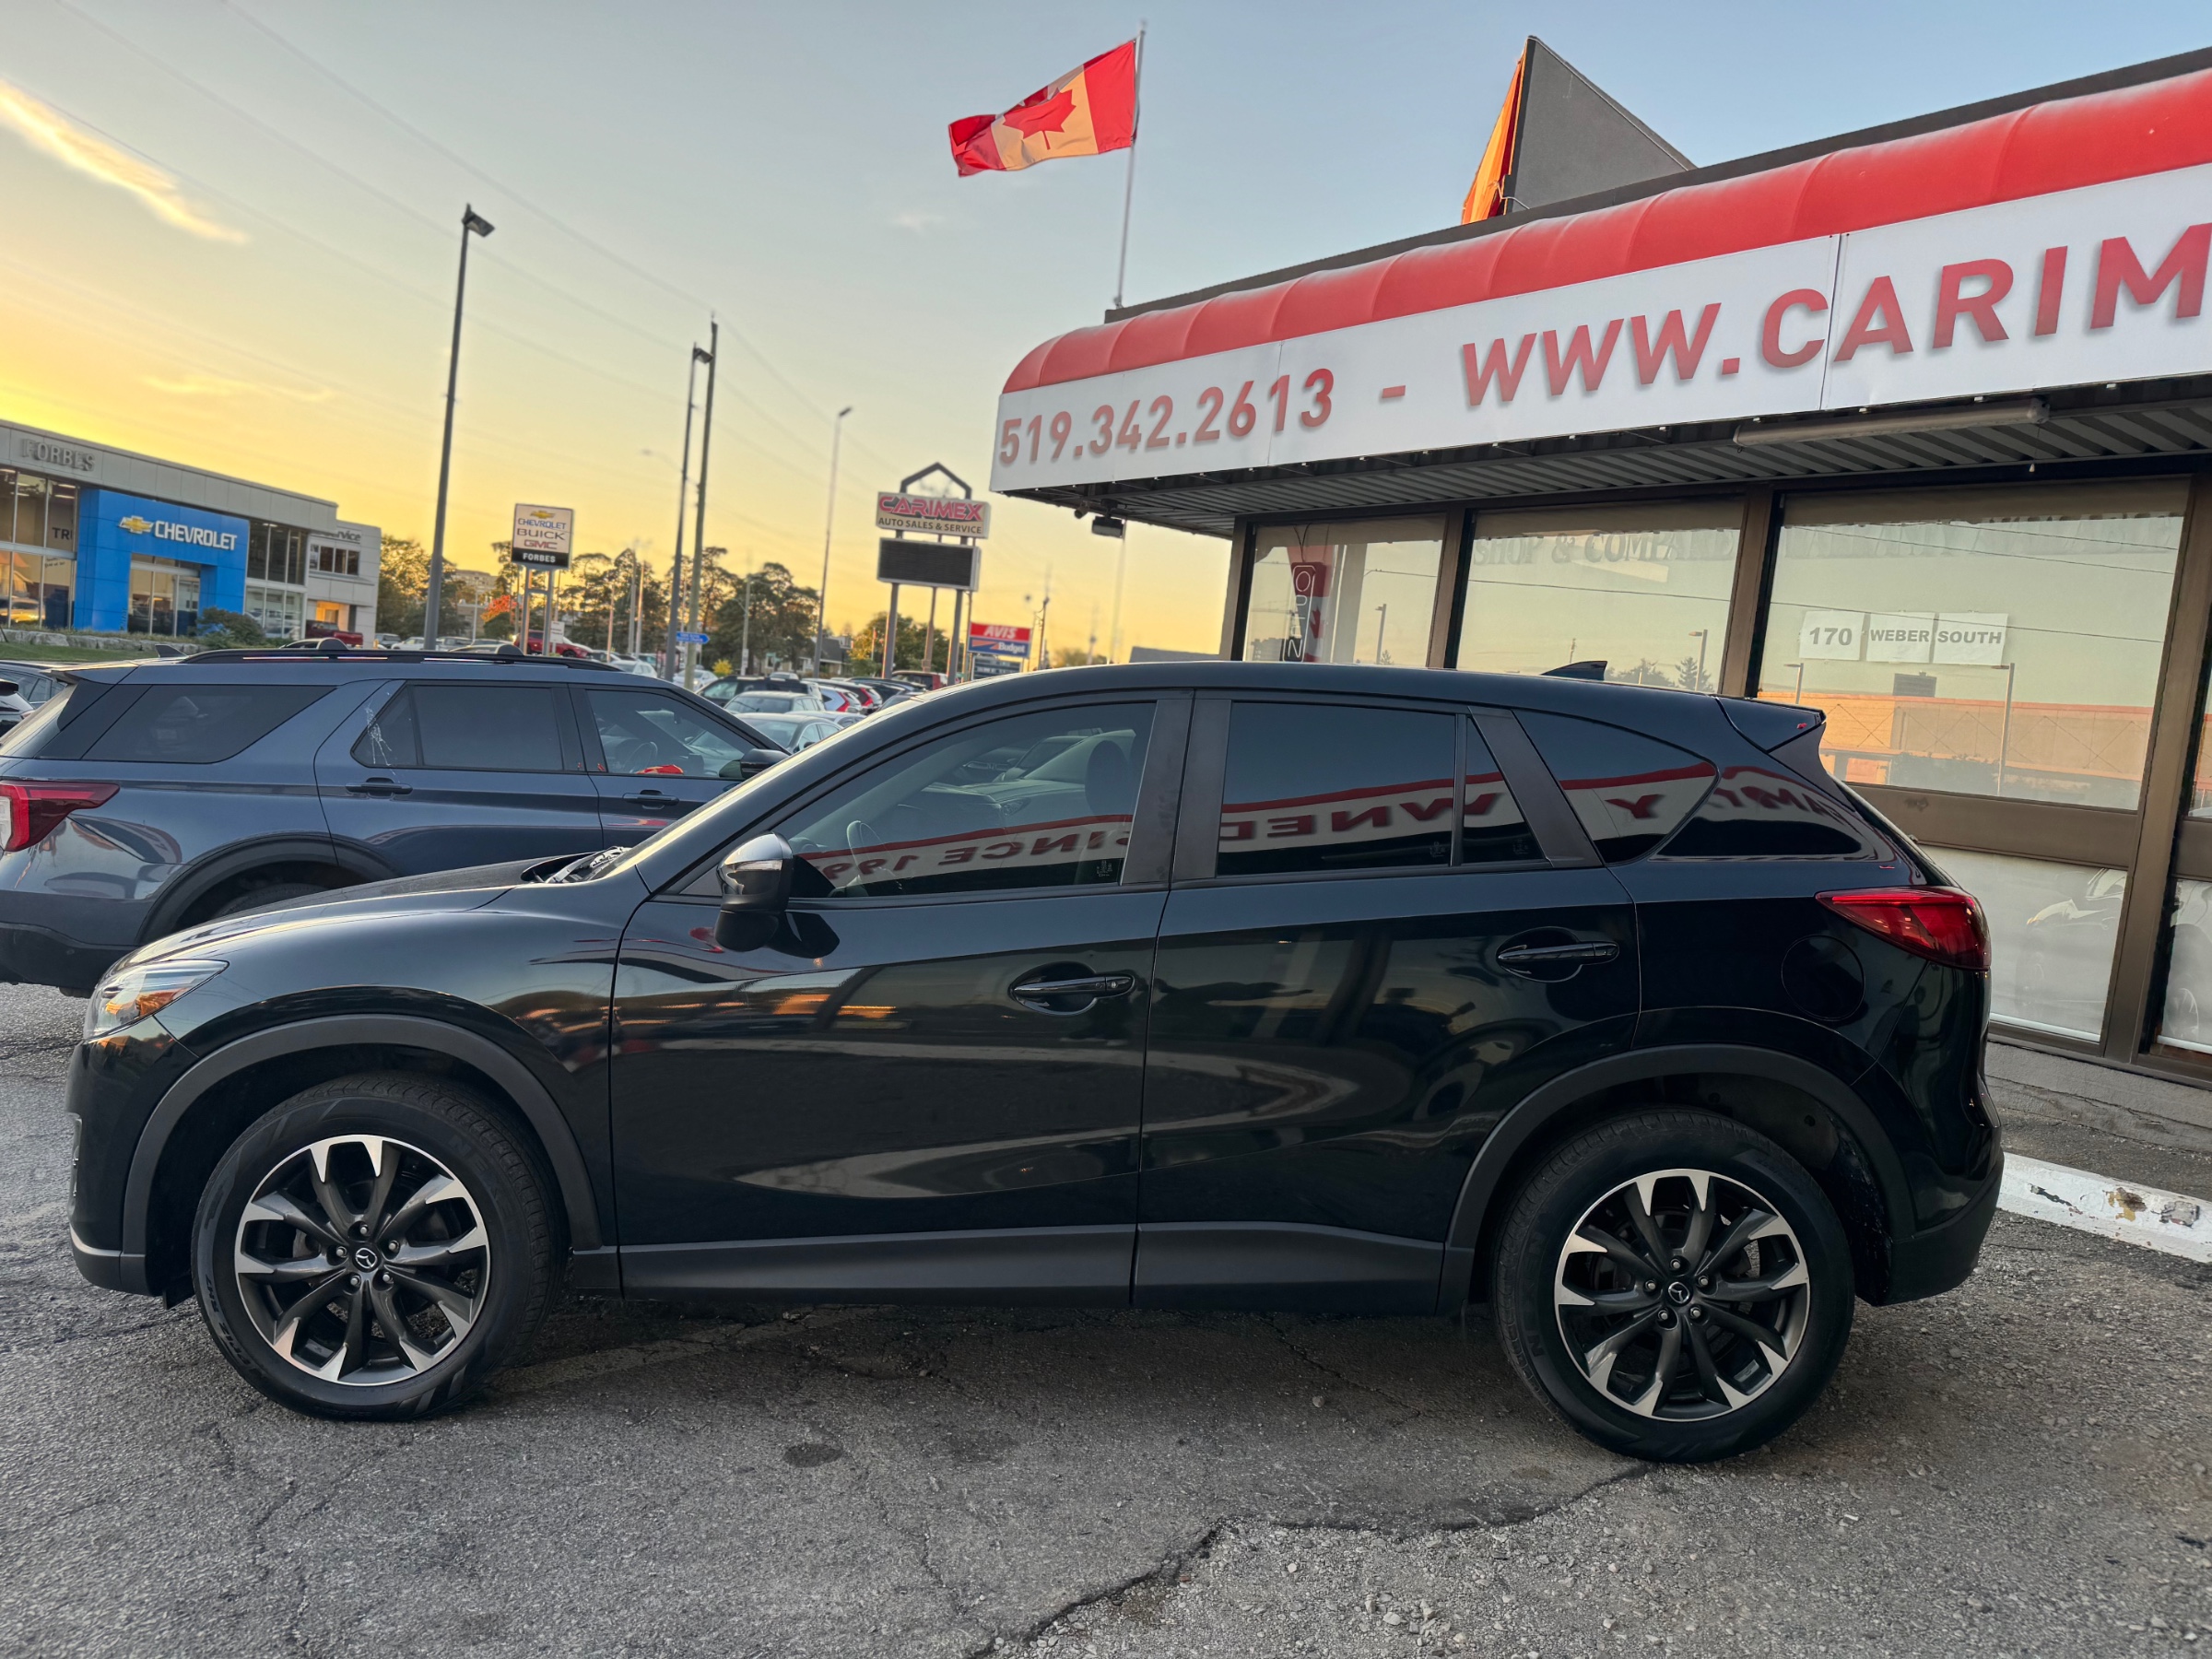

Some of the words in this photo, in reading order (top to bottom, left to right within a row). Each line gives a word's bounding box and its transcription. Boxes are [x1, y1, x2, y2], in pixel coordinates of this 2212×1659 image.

[1000, 369, 1334, 465] 519.342.2613
[22, 439, 95, 471] FORBES
[879, 496, 983, 521] CARIMEX
[518, 518, 566, 530] CHEVROLET
[878, 517, 904, 527] AUTO
[906, 520, 933, 530] SALES
[945, 524, 982, 534] SERVICE
[155, 520, 238, 551] CHEVROLET
[517, 528, 566, 540] BUICK
[524, 539, 558, 549] GMC
[523, 553, 556, 563] FORBES
[983, 625, 1018, 640] AVIS
[1809, 627, 1853, 646] 170
[1870, 629, 1930, 643] WEBER
[1937, 630, 2002, 644] SOUTH
[998, 641, 1026, 653] Budget
